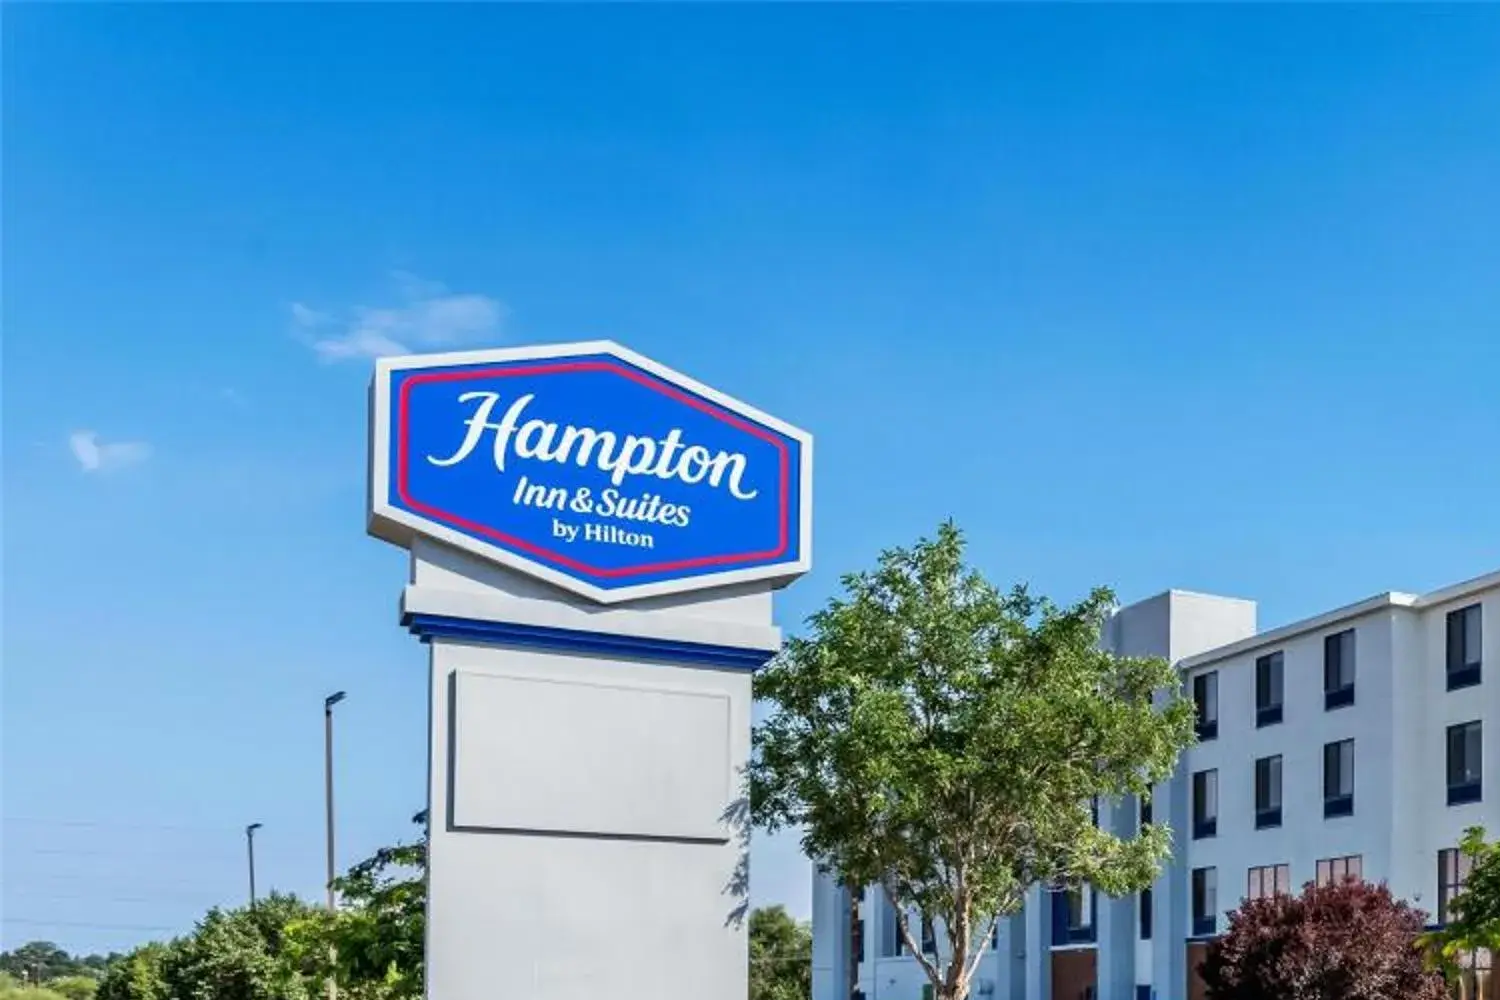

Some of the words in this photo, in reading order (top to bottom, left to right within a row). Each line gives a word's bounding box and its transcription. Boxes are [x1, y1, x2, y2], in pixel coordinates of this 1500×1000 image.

[427, 392, 758, 500] Hampton
[553, 519, 579, 542] by
[585, 523, 654, 549] Hilton
